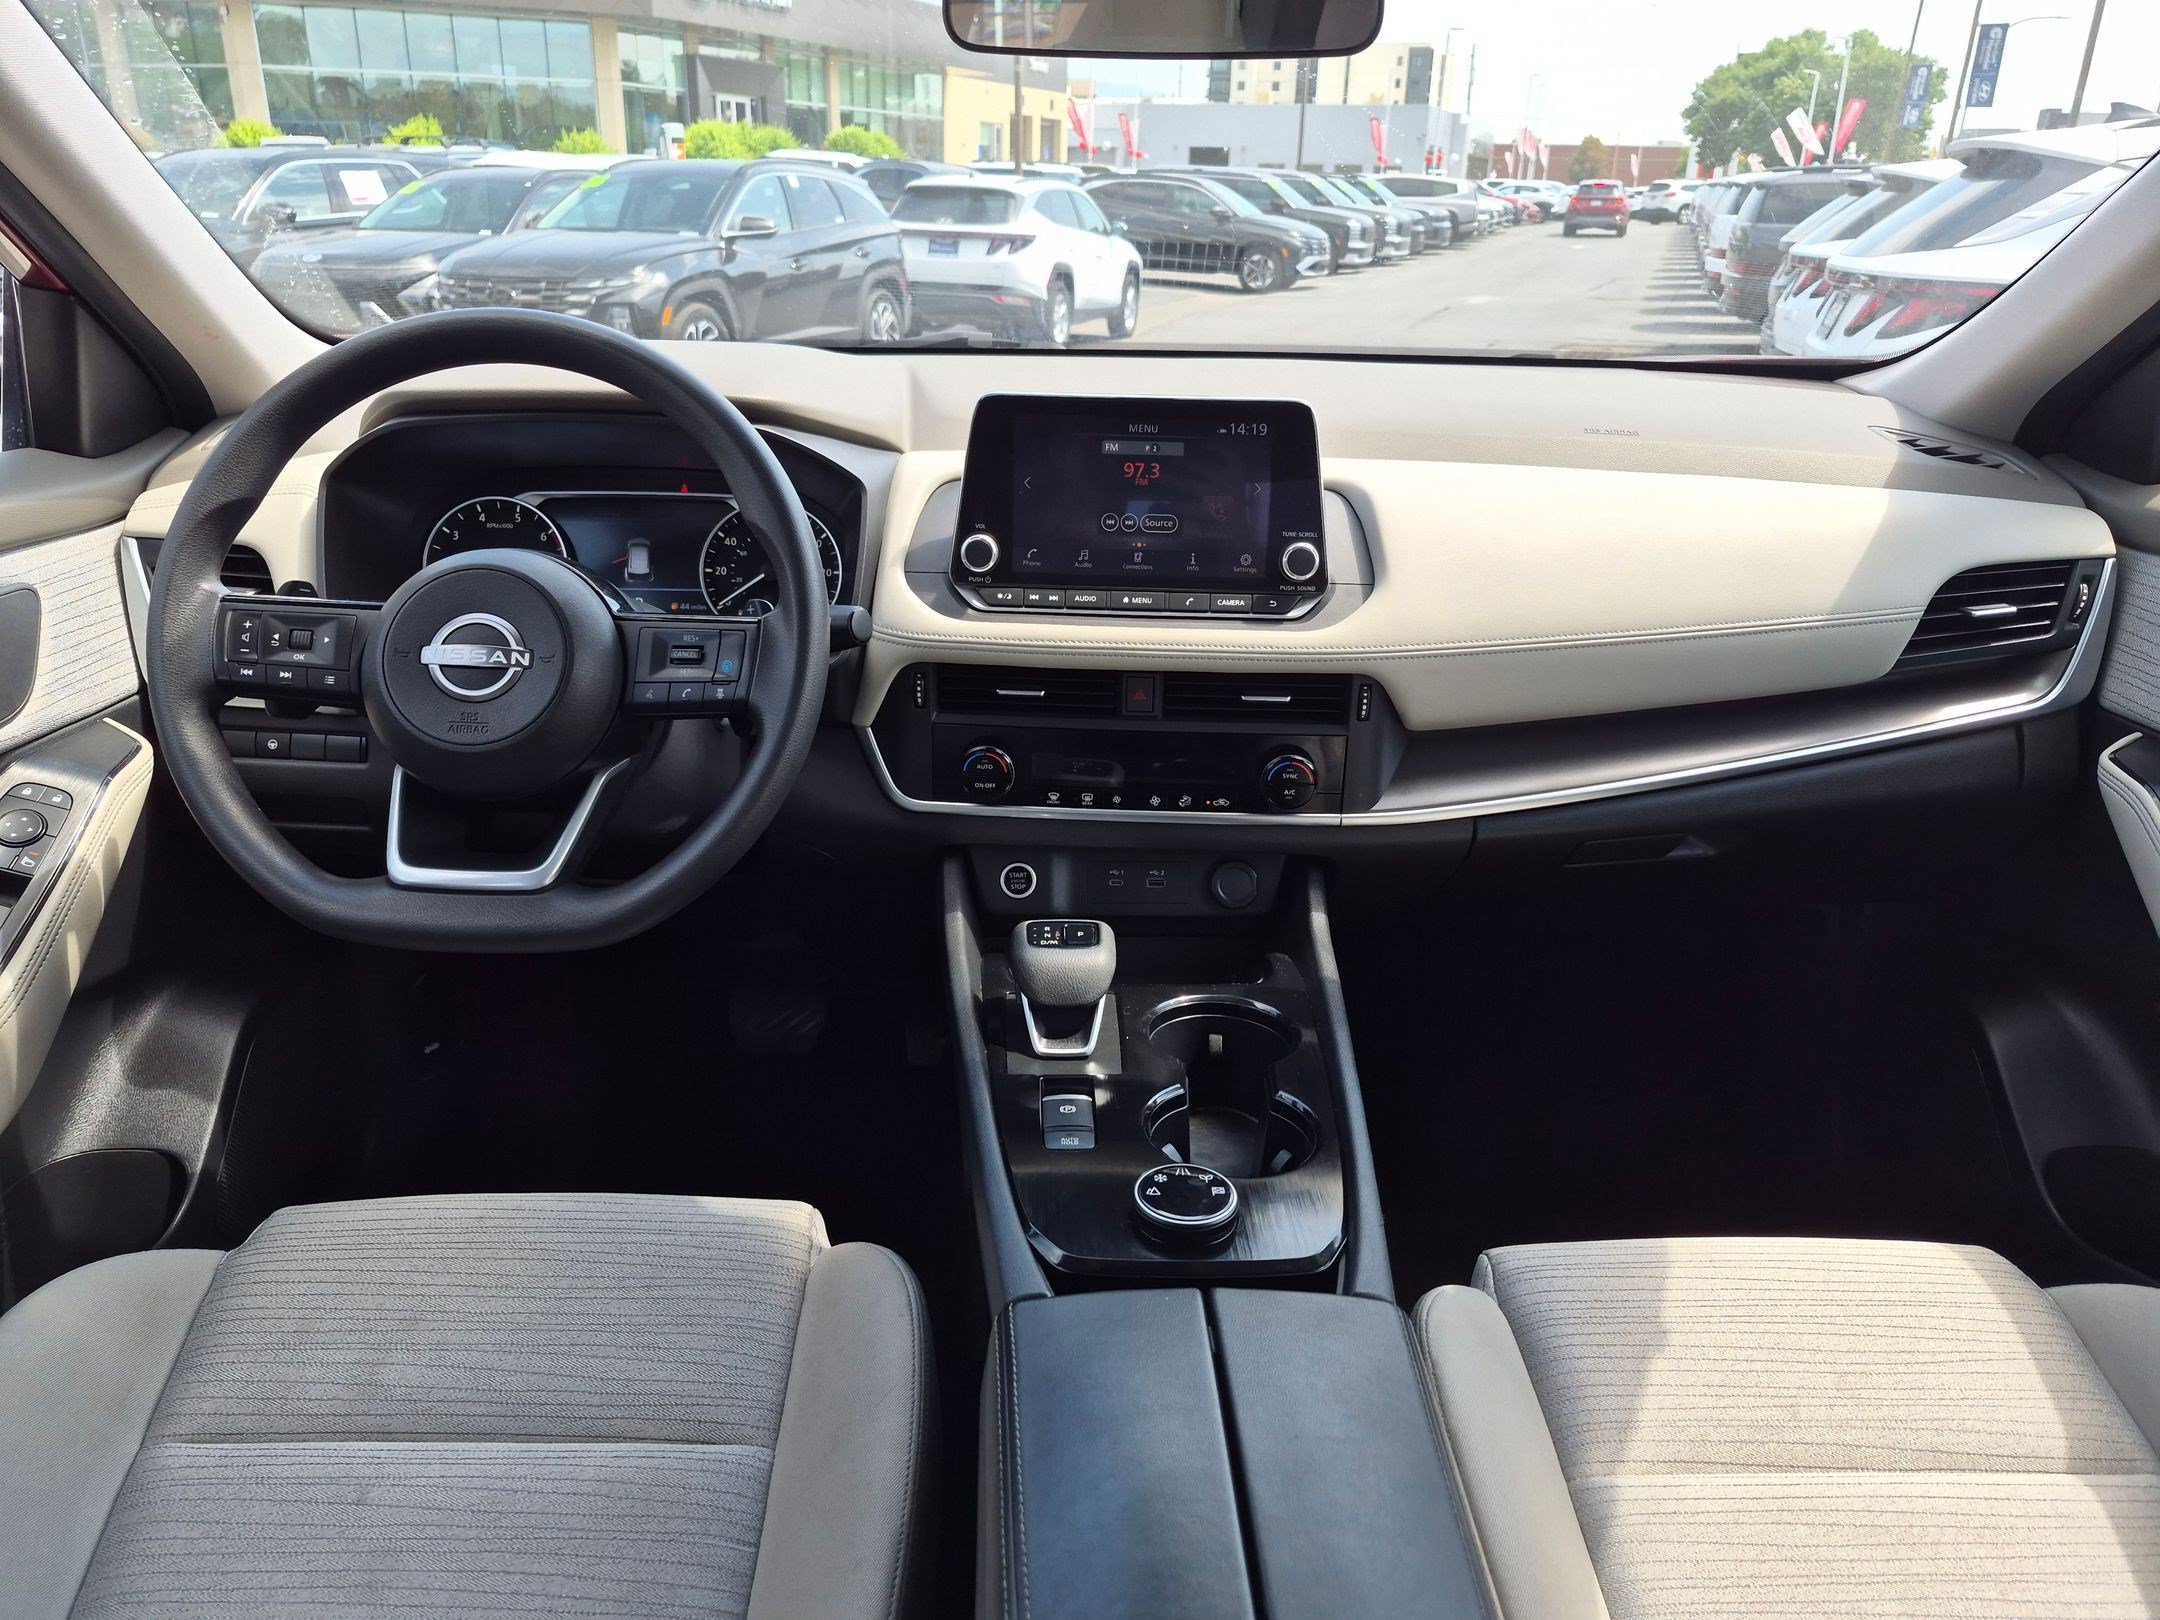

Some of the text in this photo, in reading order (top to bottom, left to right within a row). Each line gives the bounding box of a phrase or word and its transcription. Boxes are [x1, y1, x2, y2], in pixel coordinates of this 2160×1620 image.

[1128, 424, 1159, 434] MENU
[1230, 423, 1268, 436] 14:19
[1105, 443, 1119, 452] FM
[1123, 462, 1161, 479] 97.3
[478, 513, 486, 523] 4
[514, 513, 522, 523] 5
[1144, 518, 1174, 529] Source
[452, 530, 459, 540] 3
[540, 532, 547, 542] 6
[724, 537, 737, 546] 40
[715, 566, 728, 576] 20
[1122, 563, 1153, 571] Connections
[1232, 566, 1257, 574] Settings
[1074, 594, 1097, 603] AUDIO
[1131, 596, 1153, 605] MENU
[1217, 598, 1245, 607] CAMERA
[683, 634, 700, 642] RES+
[423, 648, 530, 666] NISSAN
[459, 711, 480, 722] SRS
[447, 724, 490, 735] AIRBAG
